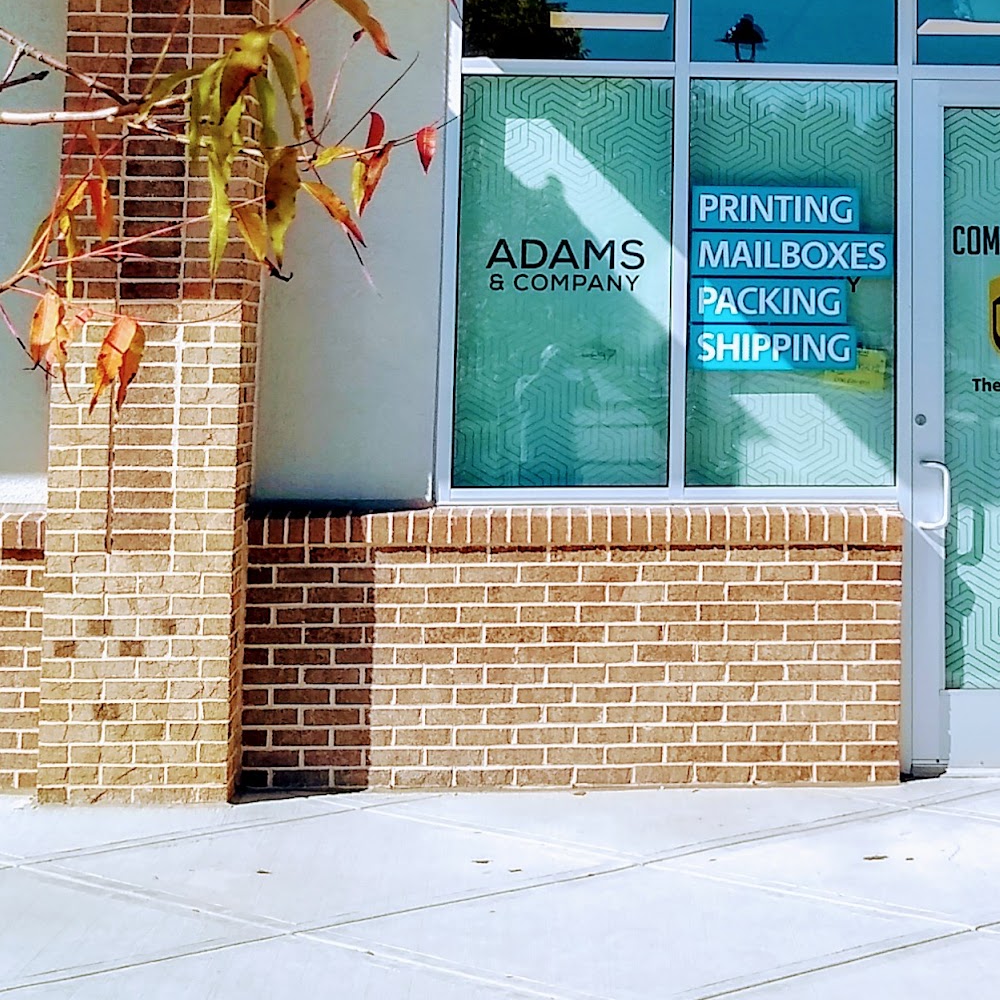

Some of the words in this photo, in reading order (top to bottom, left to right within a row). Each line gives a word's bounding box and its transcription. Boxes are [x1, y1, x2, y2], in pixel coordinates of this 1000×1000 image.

[699, 193, 853, 224] PRINTING
[486, 238, 646, 271] ADAMS
[698, 240, 887, 270] MAILBOXES
[489, 273, 505, 291] &
[513, 273, 641, 292] COMPANY
[698, 287, 841, 316] PACKING
[697, 333, 851, 363] SHIPPING
